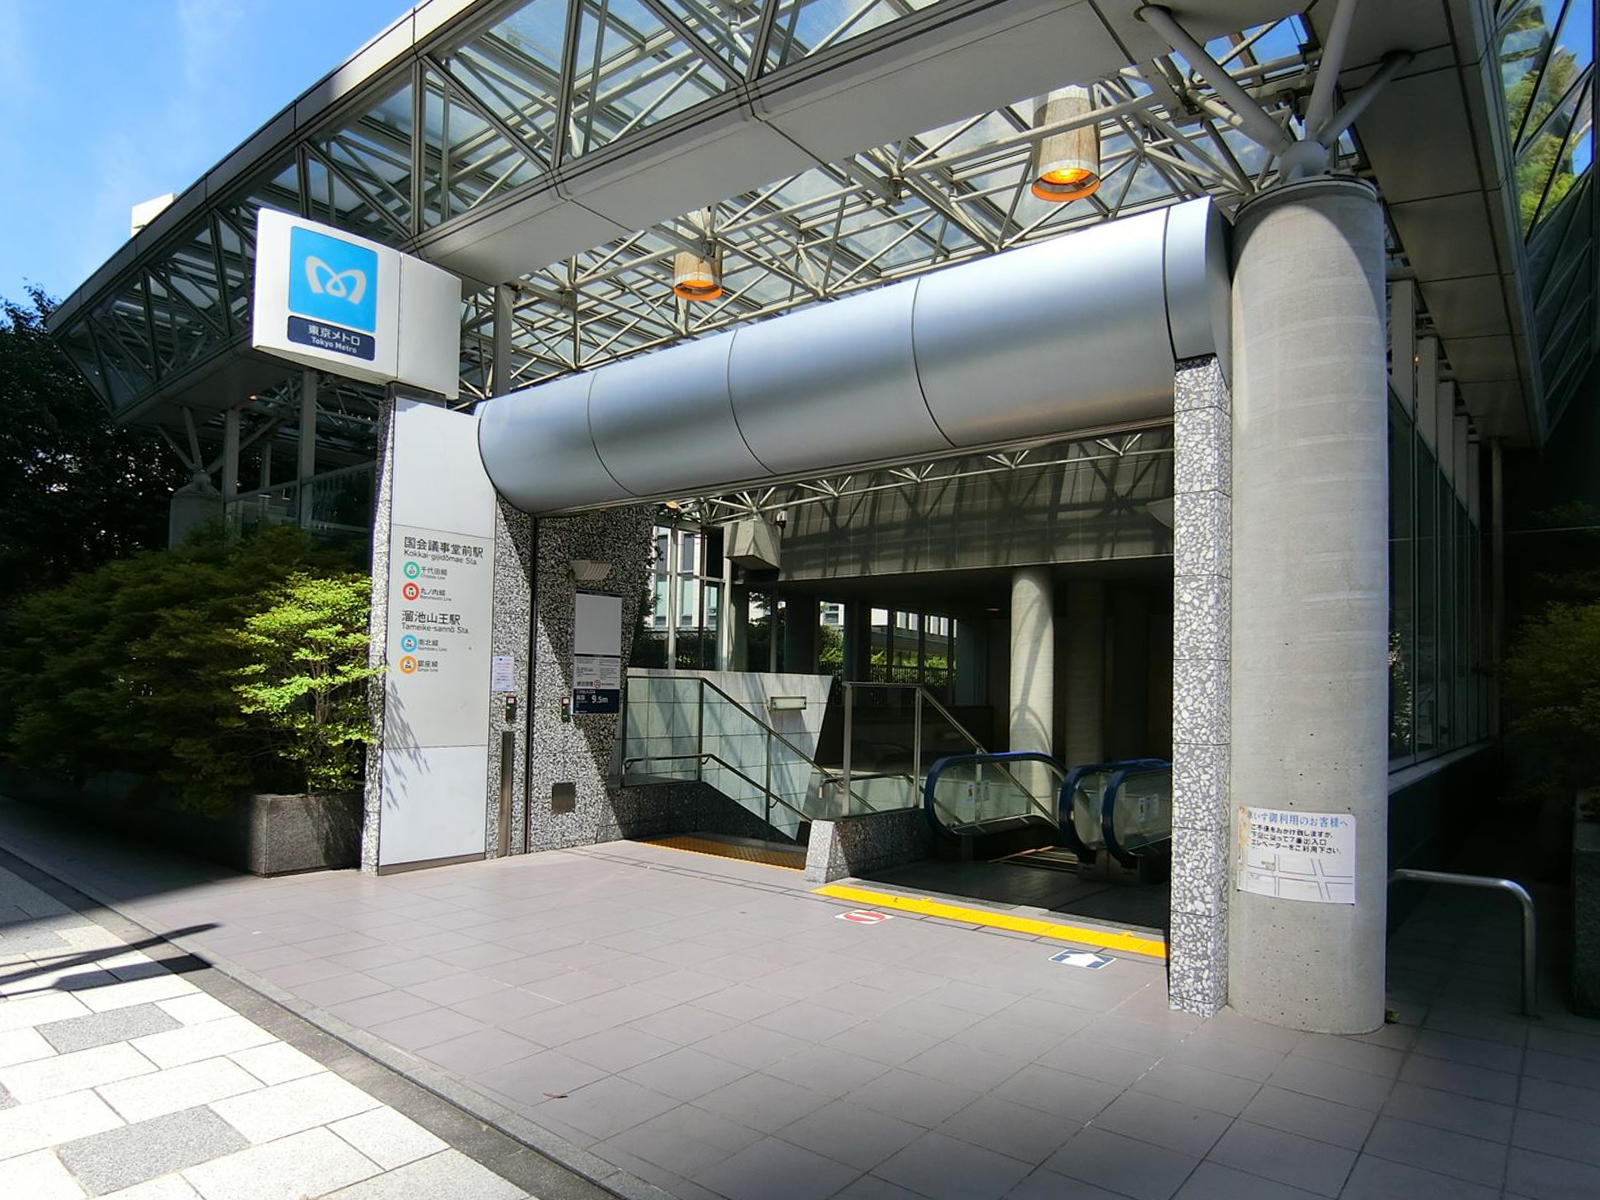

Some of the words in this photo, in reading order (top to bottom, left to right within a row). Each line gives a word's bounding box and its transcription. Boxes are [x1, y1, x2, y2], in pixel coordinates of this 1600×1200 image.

[307, 324, 360, 346] 東京メトロ
[311, 336, 334, 348] Tokyo
[335, 342, 357, 354] Metro
[404, 536, 484, 559] 国会議事堂前駅
[420, 566, 447, 576] 千代田線
[402, 609, 461, 625] 溜池山王駅
[1247, 811, 1349, 828] いす御利用のお客様へ
